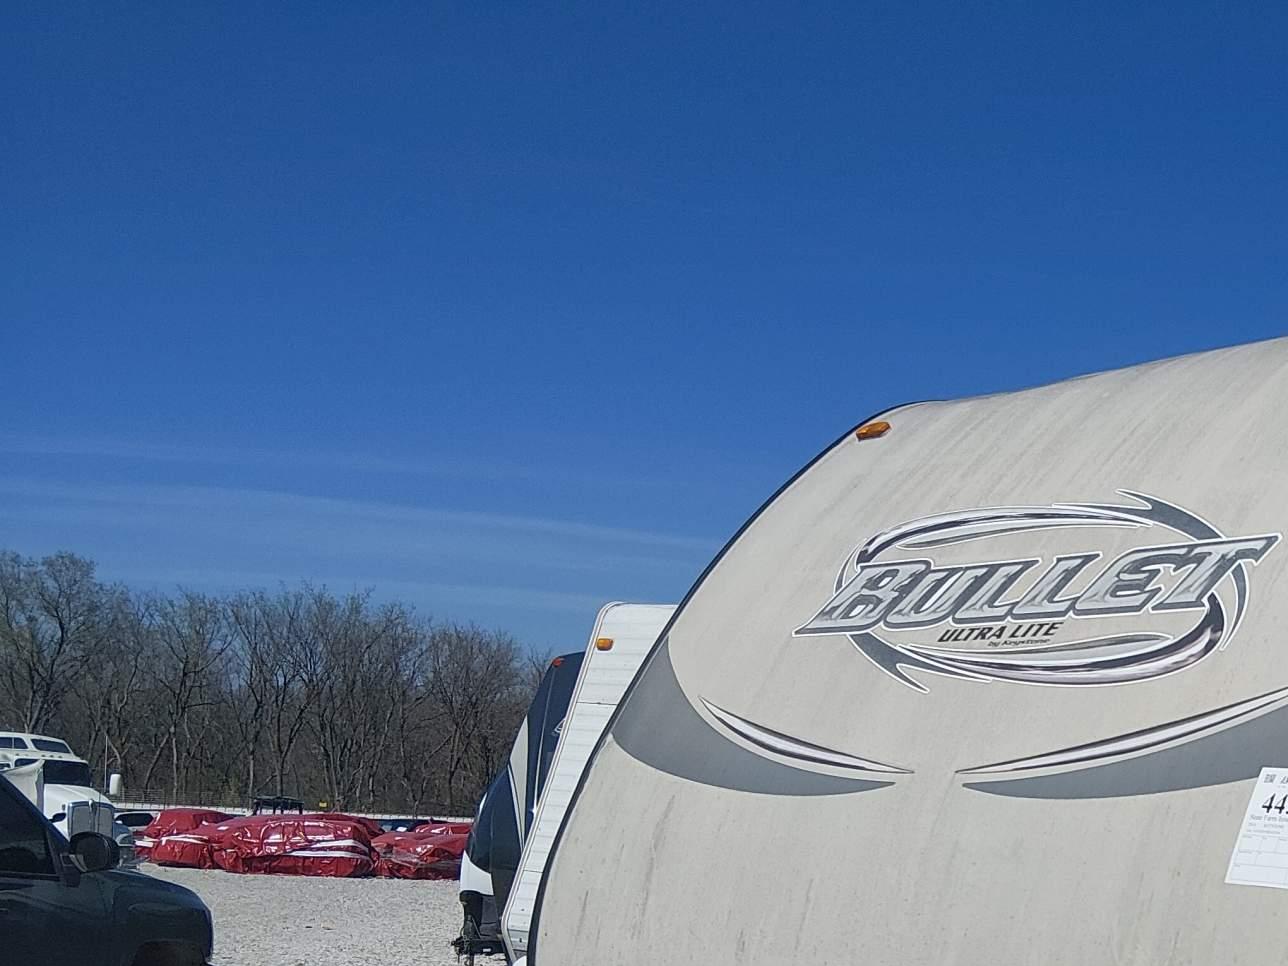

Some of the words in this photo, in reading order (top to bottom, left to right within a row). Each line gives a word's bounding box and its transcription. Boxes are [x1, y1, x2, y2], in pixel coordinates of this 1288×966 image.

[793, 533, 1281, 636] BULLET
[937, 625, 1008, 642] ULTRA
[1009, 621, 1064, 638] LITE
